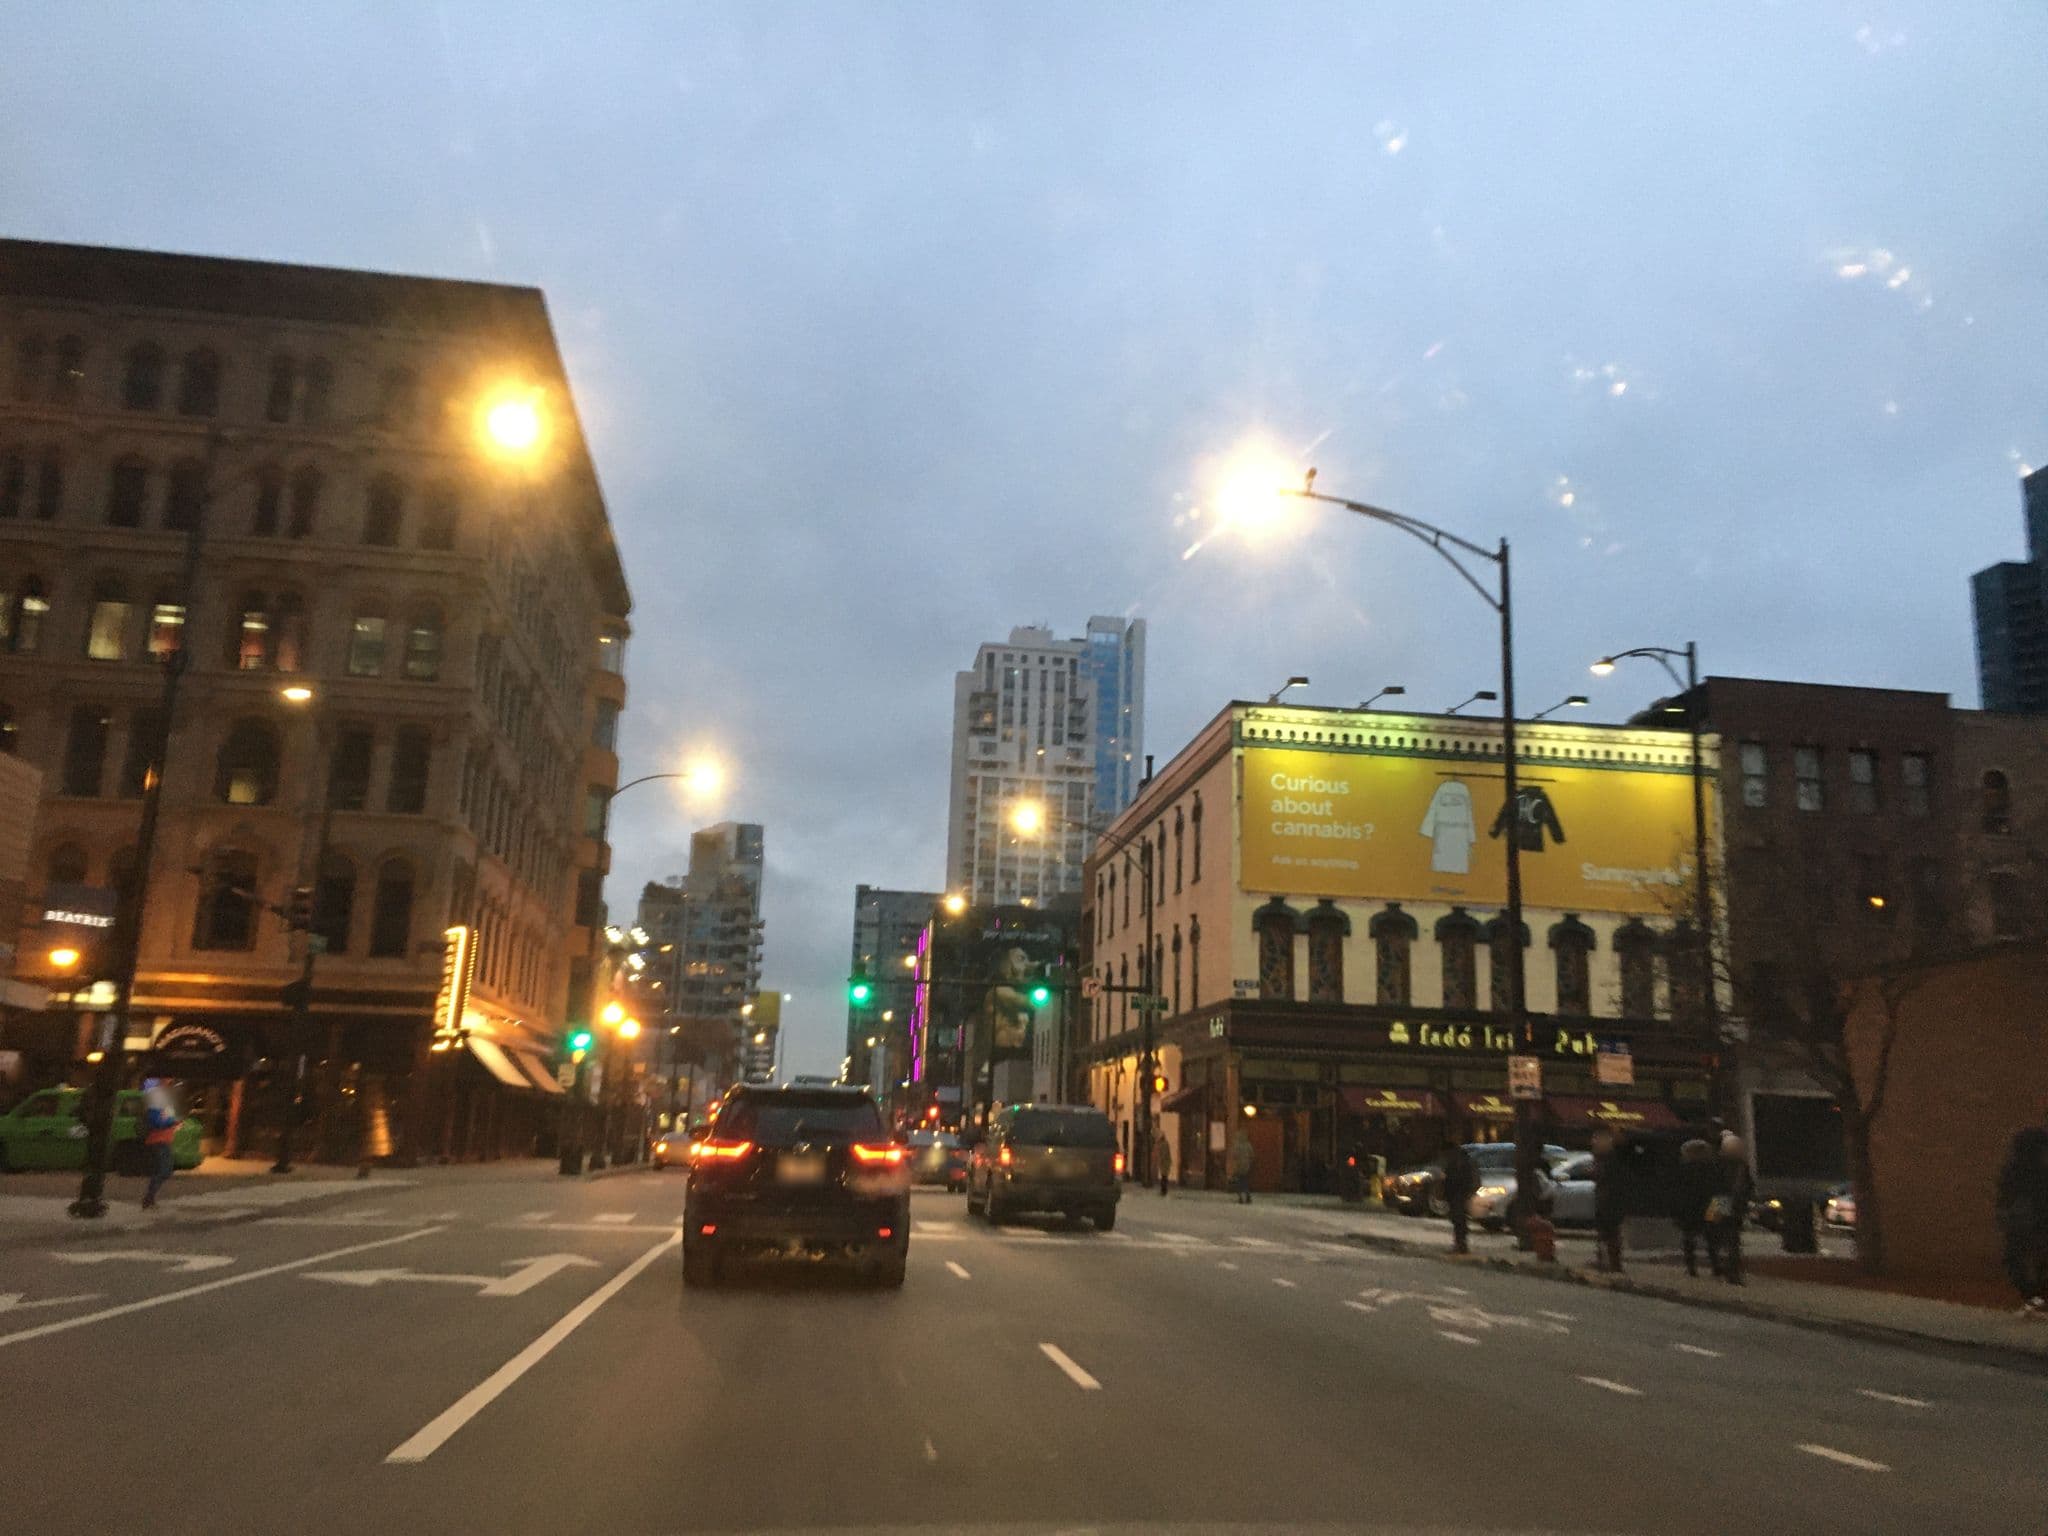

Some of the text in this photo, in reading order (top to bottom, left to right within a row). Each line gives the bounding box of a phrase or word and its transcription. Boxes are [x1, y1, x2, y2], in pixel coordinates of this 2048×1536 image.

[1270, 772, 1349, 795] Curious
[1270, 796, 1333, 816] about
[1271, 820, 1375, 840] cannabis?
[43, 909, 116, 927] BEATRIX
